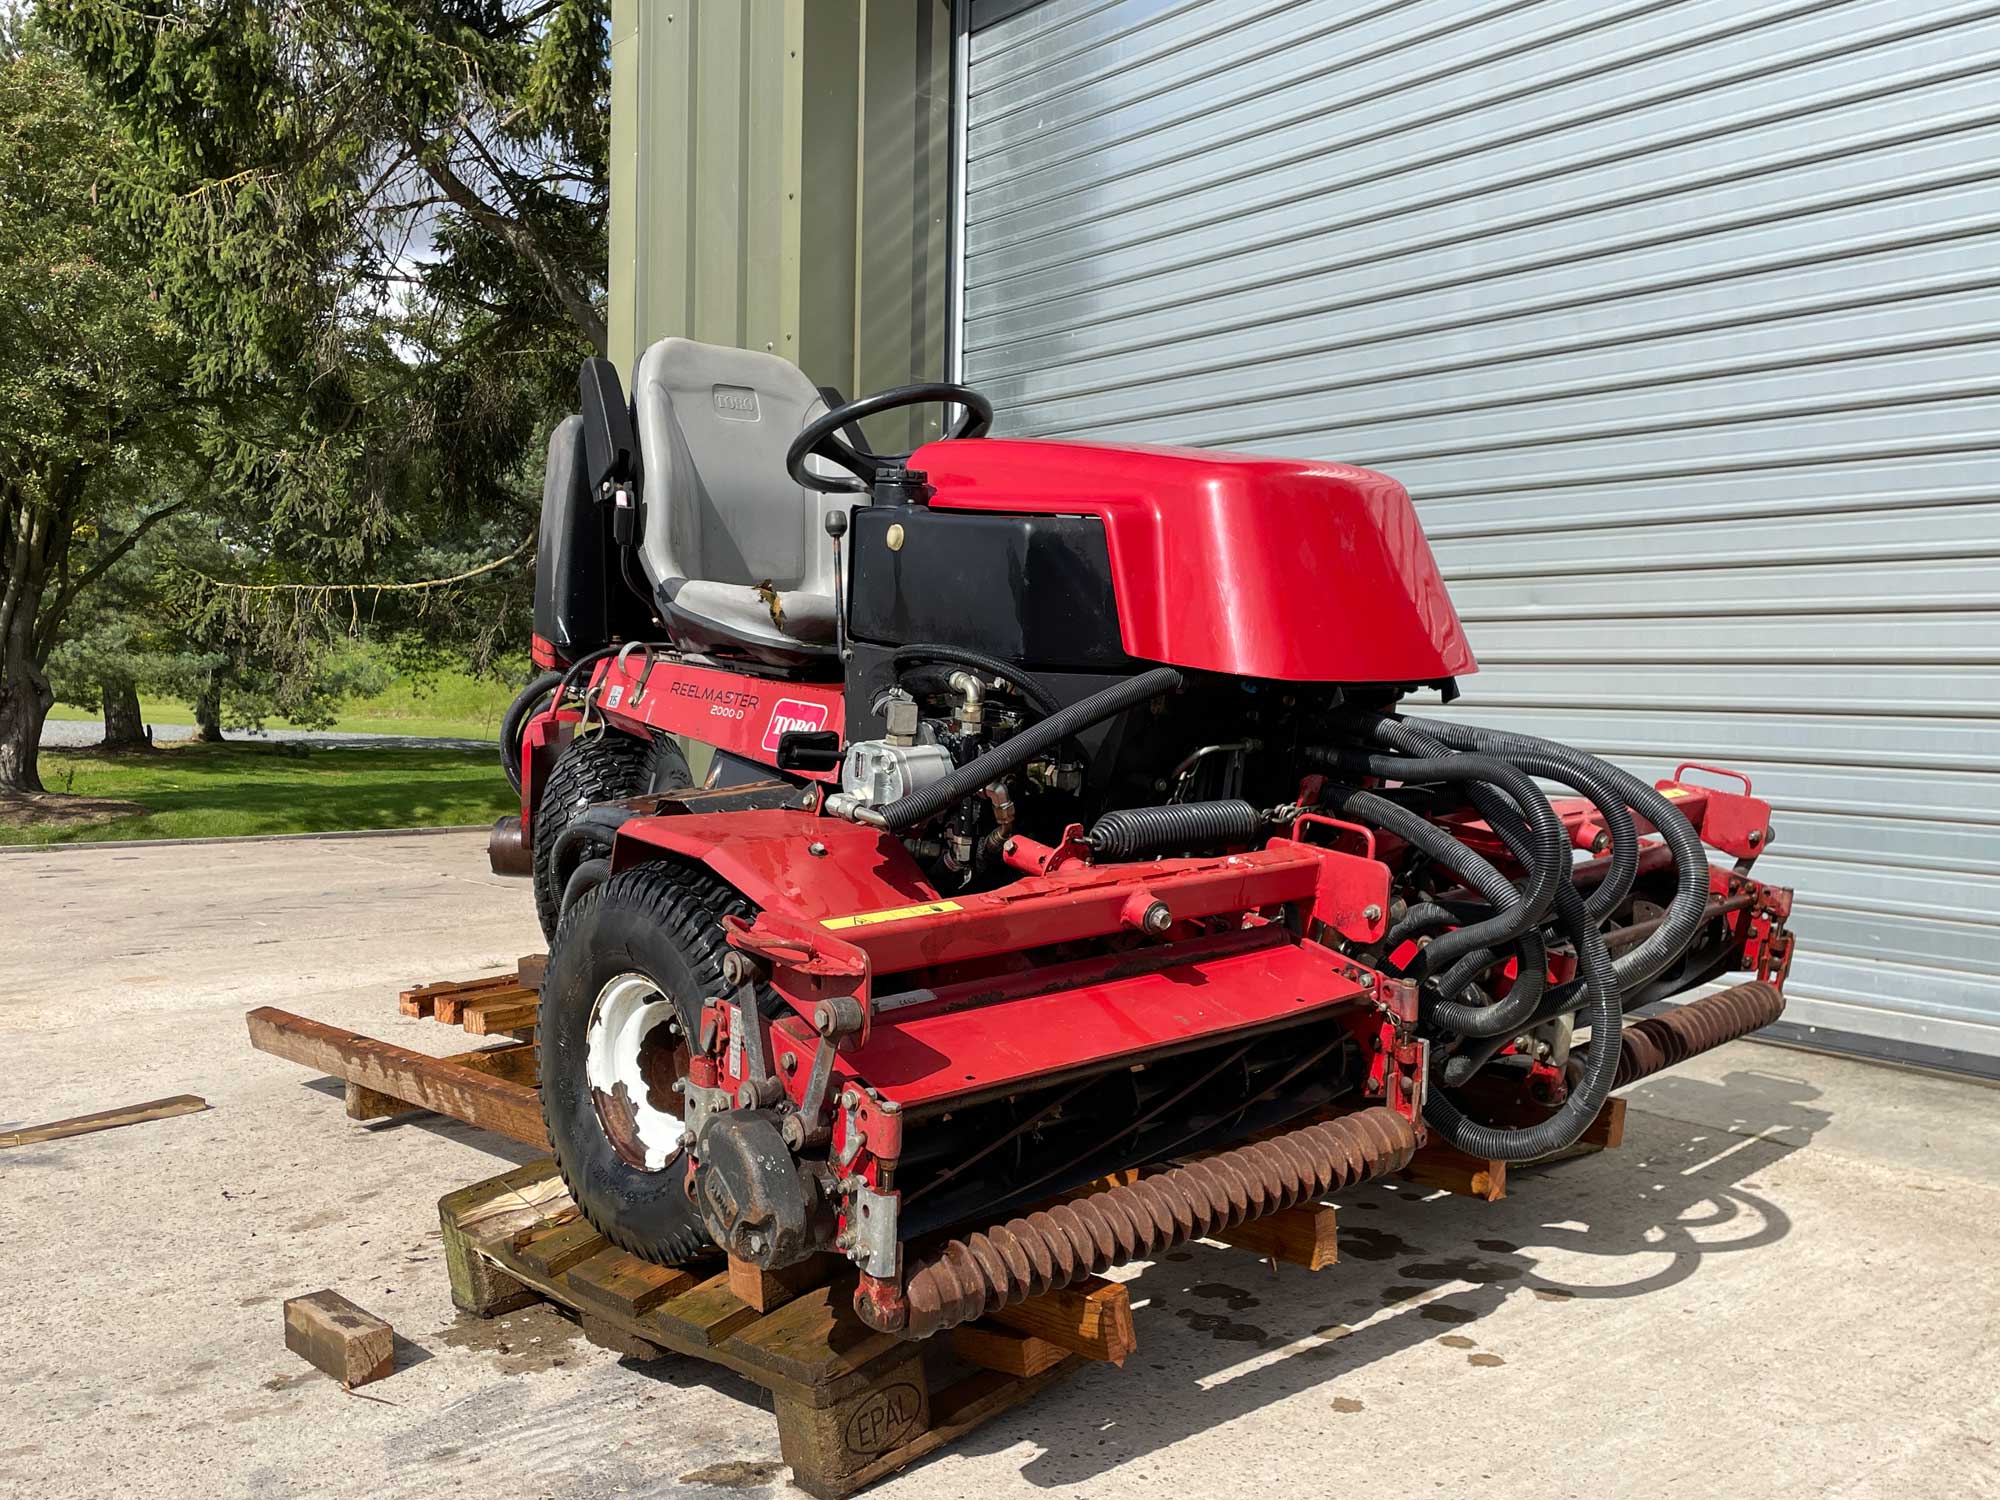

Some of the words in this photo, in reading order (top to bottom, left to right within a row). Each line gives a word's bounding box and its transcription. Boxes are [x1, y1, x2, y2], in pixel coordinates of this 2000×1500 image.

[670, 681, 760, 709] REELMASTER
[772, 715, 817, 734] TORO
[857, 1394, 913, 1446] EPAL
